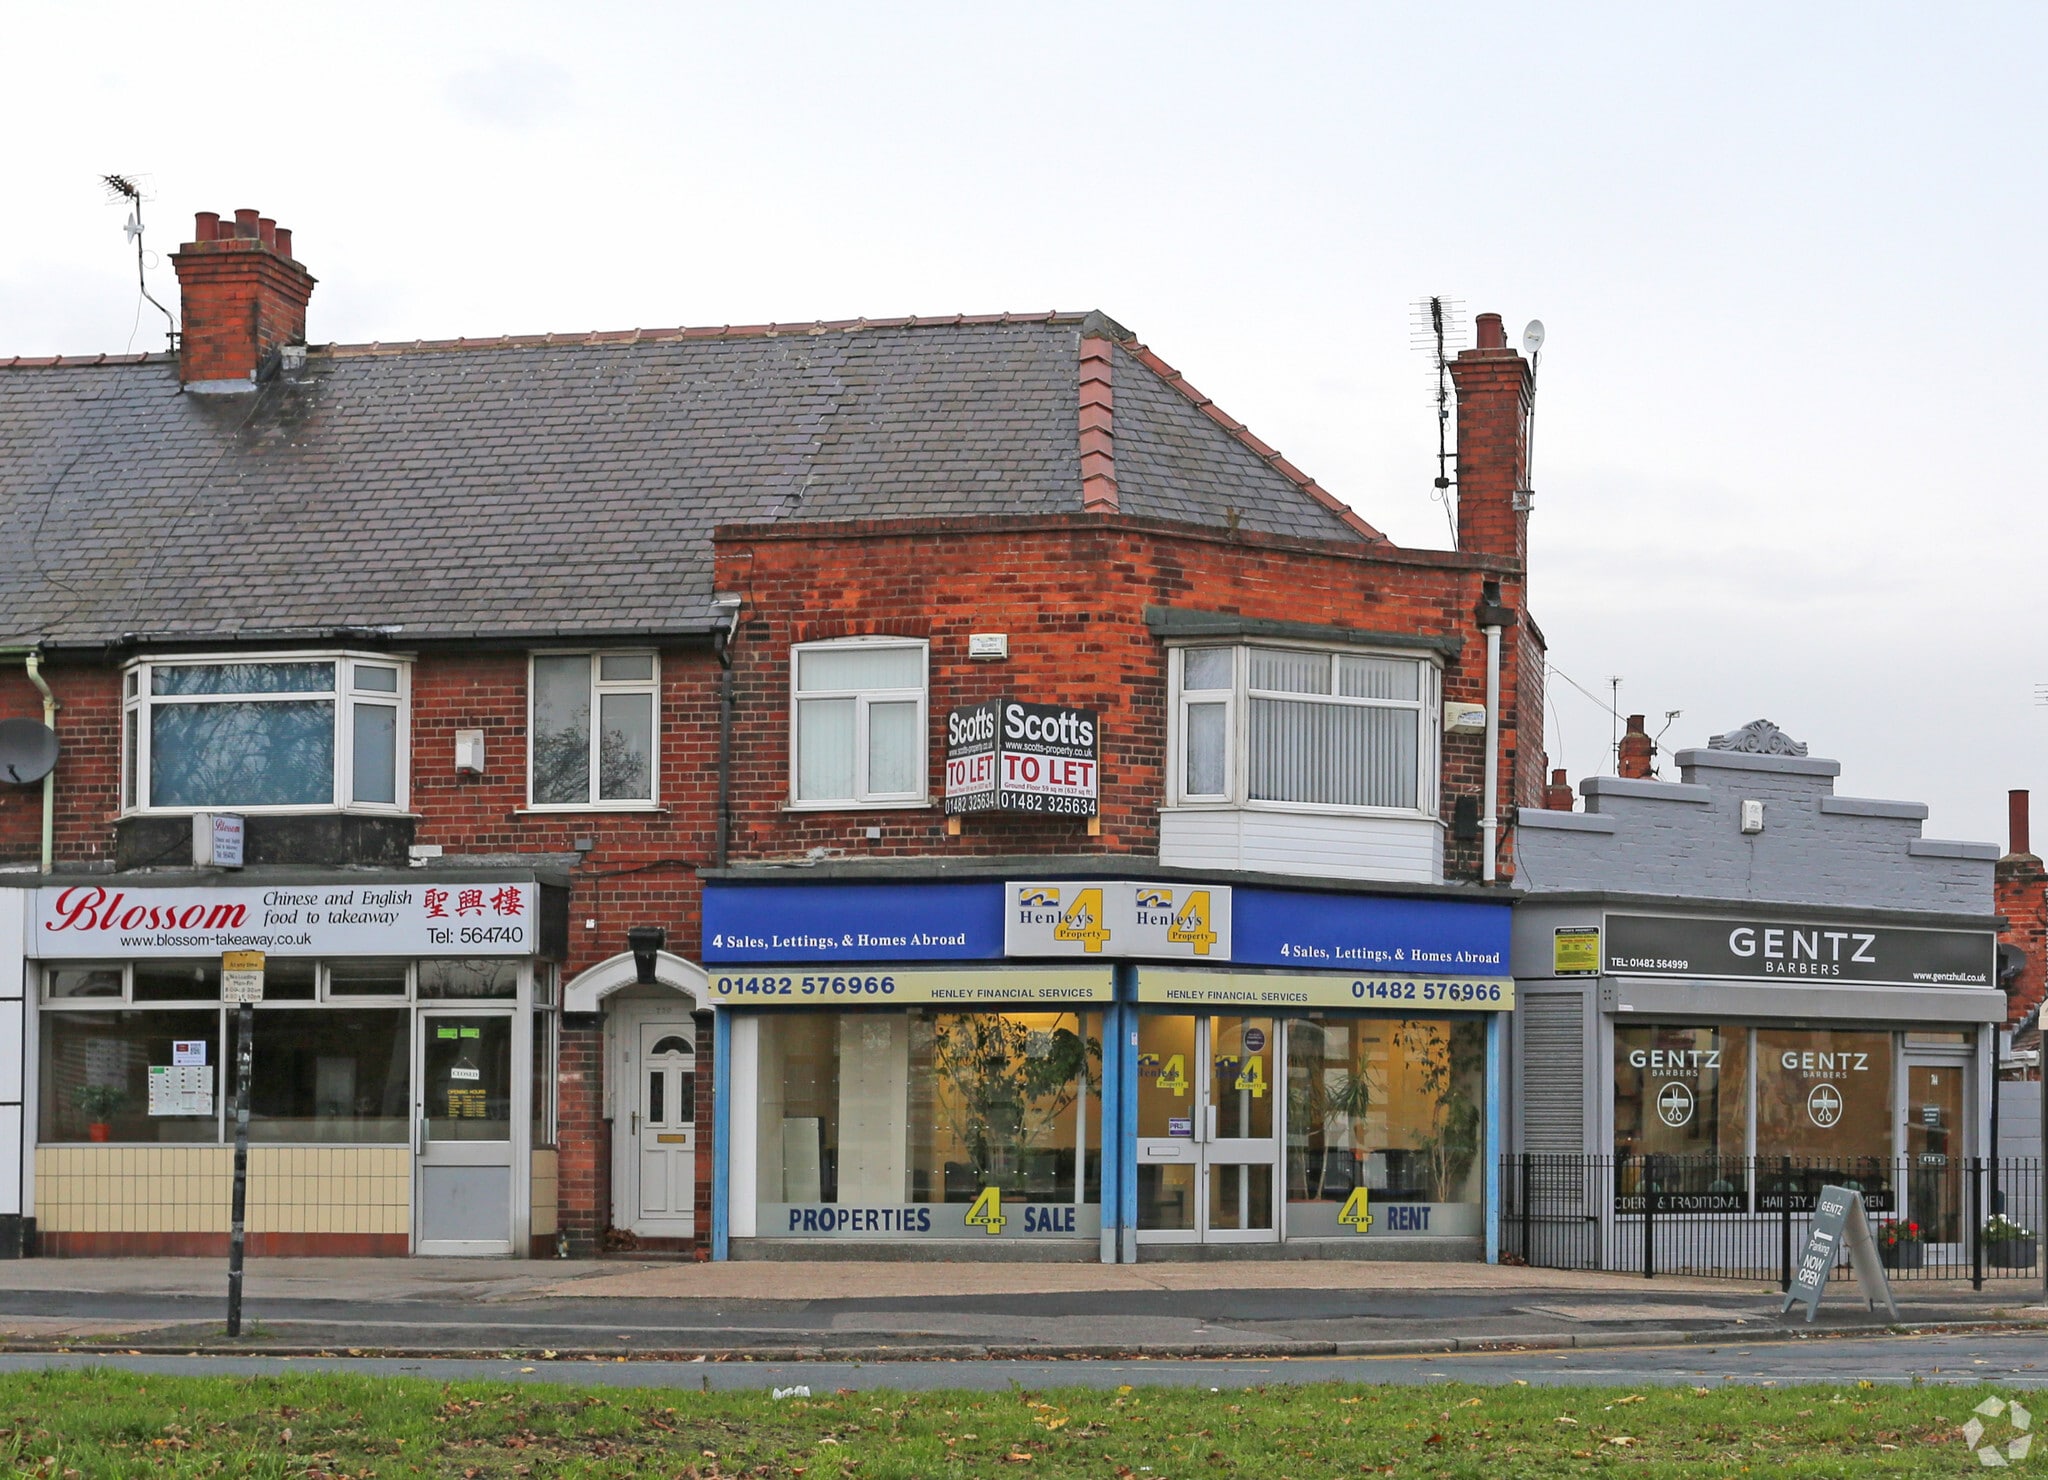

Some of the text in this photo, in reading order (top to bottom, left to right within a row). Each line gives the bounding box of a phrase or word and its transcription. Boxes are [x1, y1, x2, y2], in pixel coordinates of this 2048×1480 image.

[949, 707, 994, 746] Scotts
[1005, 704, 1094, 746] Scotts
[1005, 741, 1093, 757] www.scotts-property.co.uk
[948, 755, 994, 787] TO LET
[1004, 755, 1093, 787] TO LET
[1004, 782, 1025, 790] Ground
[1026, 783, 1040, 791] Floor
[945, 792, 994, 815] 01482 325634
[1001, 792, 1096, 815] 01482 325634
[45, 886, 251, 931] Blossom
[263, 890, 412, 909] Chinese and English
[423, 886, 525, 919] 聖興樓
[263, 909, 400, 927] food to takeaway
[1020, 911, 1094, 930] Henleys
[1054, 888, 1111, 953] 4
[1136, 911, 1203, 929] Henleys
[1167, 890, 1217, 955] 4
[120, 933, 312, 948] www.blossom-takeaway.co.uk
[427, 926, 523, 944] Tel: 564740
[713, 933, 966, 949] 4 Sales, Lettings, & Homes Abroad
[1060, 930, 1101, 940] Property
[1172, 932, 1209, 941] Property
[1280, 943, 1500, 964] 4 Sales, Lettings, & Homes Abroad
[1729, 927, 1876, 963] GENTZ
[1611, 957, 1688, 969] TEL: 01482 564999
[1766, 962, 1839, 975] BARBERS
[717, 976, 895, 995] 01482 576966
[1913, 971, 1986, 982] www.gentzhull.co.uk
[931, 988, 1093, 998] HENLEY FINANCIAL SERVICES
[1167, 990, 1308, 1002] HENLEY FINANCIAL SERVICES
[1352, 981, 1501, 1001] 01482 576966
[1629, 1050, 1720, 1068] GENTZ
[1781, 1052, 1868, 1071] GENTZ
[452, 1070, 478, 1078] CLOSED
[1156, 1054, 1189, 1096] 4
[1235, 1055, 1267, 1097] 4
[1652, 1069, 1698, 1077] BARBERS
[1803, 1071, 1847, 1079] BARBERS
[964, 1186, 1007, 1235] 4
[1337, 1186, 1374, 1233] 4
[1821, 1201, 1843, 1216] GENTZ
[789, 1207, 931, 1232] PROPERTIES
[1024, 1206, 1076, 1233] SALE
[1387, 1206, 1431, 1231] RENT
[1808, 1239, 1830, 1257] Parking
[1803, 1254, 1825, 1272] NOW
[1798, 1268, 1821, 1286] OPEN
